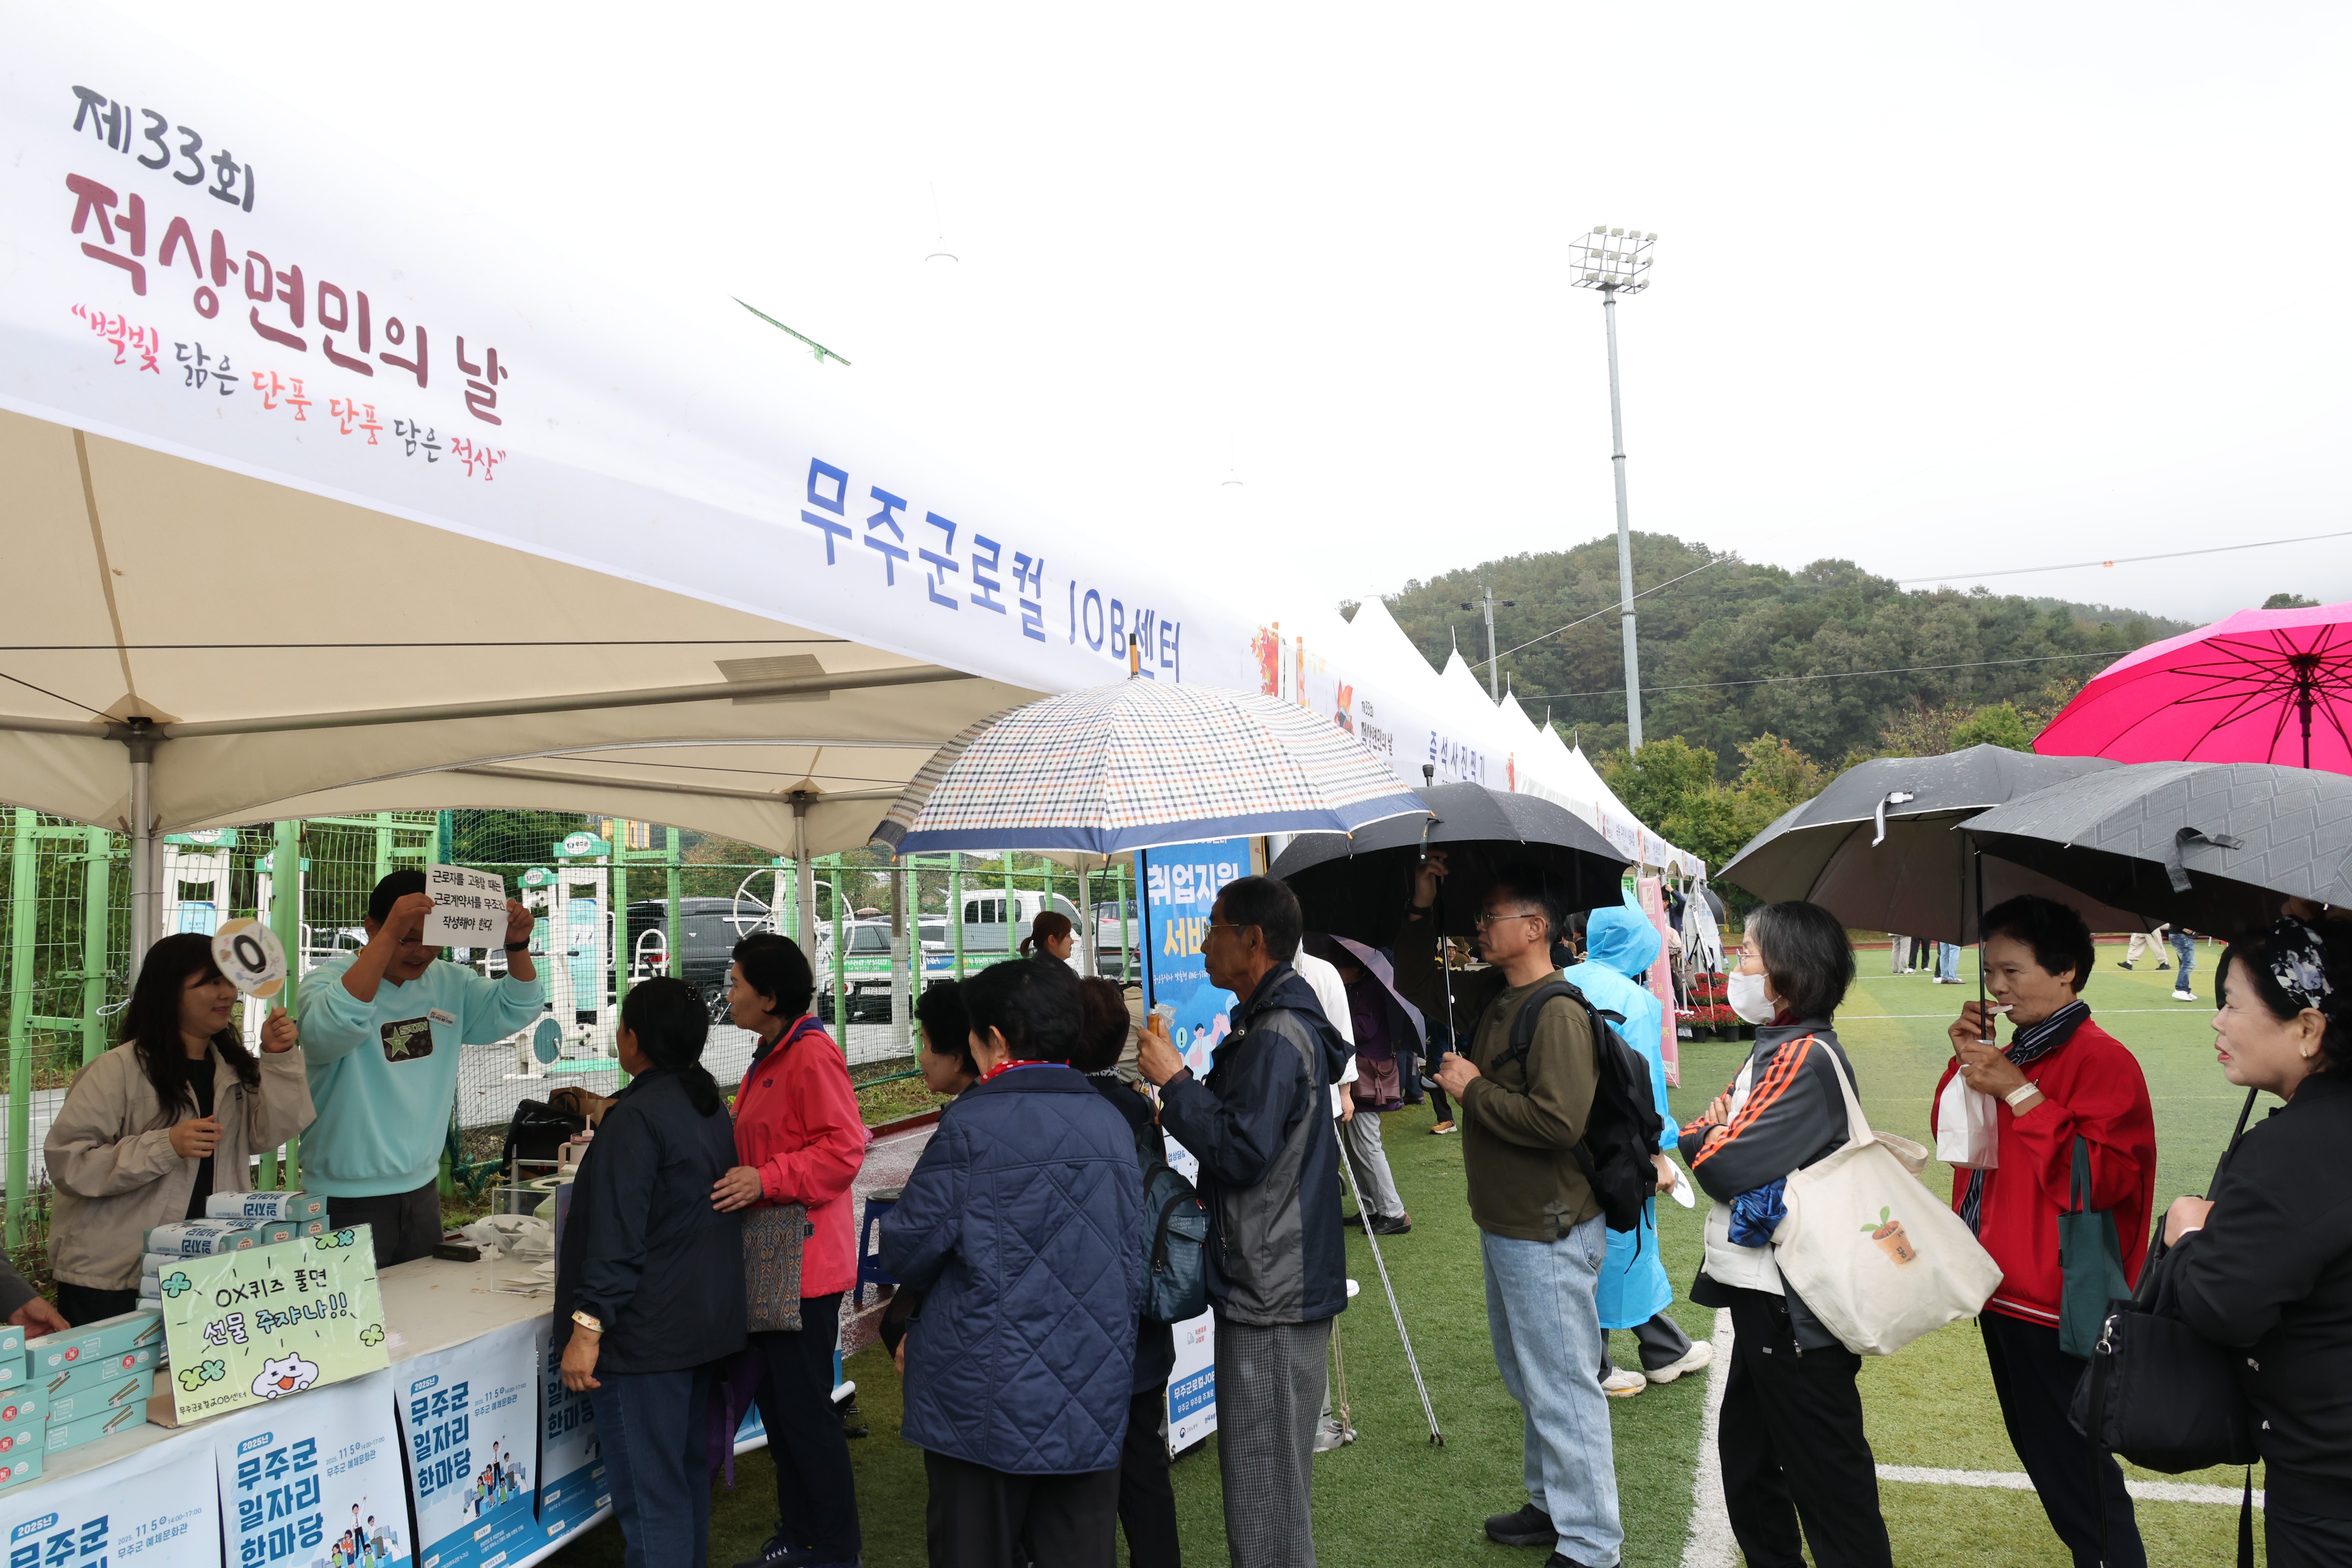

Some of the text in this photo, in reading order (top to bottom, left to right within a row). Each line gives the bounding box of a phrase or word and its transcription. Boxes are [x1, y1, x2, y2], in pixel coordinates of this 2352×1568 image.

[71, 85, 255, 213] 제33회
[66, 173, 509, 425] 적상면민의 날
[174, 341, 238, 396] 닮은
[252, 371, 312, 421] 단풍
[329, 398, 384, 444] 단풍
[394, 418, 442, 464] 담은
[801, 457, 1046, 643] 무주군로컬
[1387, 733, 1394, 757] 날
[432, 870, 502, 892] 근로자를 고용할 때는
[1147, 862, 1240, 906] 취업지원
[434, 893, 507, 911] 근로계약서를 무조건
[443, 916, 476, 930] 작성해야
[925, 956, 941, 965] NH
[1175, 970, 1187, 982] 맞춤형
[399, 1021, 428, 1036] SUN
[243, 1203, 277, 1216] 일자리
[181, 1239, 212, 1255] 일자리
[216, 1269, 327, 1308] OX퀴즈 풀면
[204, 1312, 249, 1346] 선물
[415, 1377, 435, 1391] 2025년
[411, 1380, 469, 1427] 무주군
[474, 1405, 490, 1418] 무주군
[242, 1434, 269, 1451] 2025년
[413, 1413, 469, 1463] 일자리
[238, 1436, 318, 1491] 무주군
[327, 1449, 376, 1478] 무주군 예체문화관
[418, 1447, 471, 1499] 한마당
[238, 1473, 321, 1533] 일자리
[10, 1514, 109, 1568] 무주군
[17, 1515, 53, 1537] 2025년
[117, 1522, 188, 1559] 무주군 예체문화관
[118, 1535, 134, 1546] 2025.
[240, 1511, 324, 1568] 한마당
